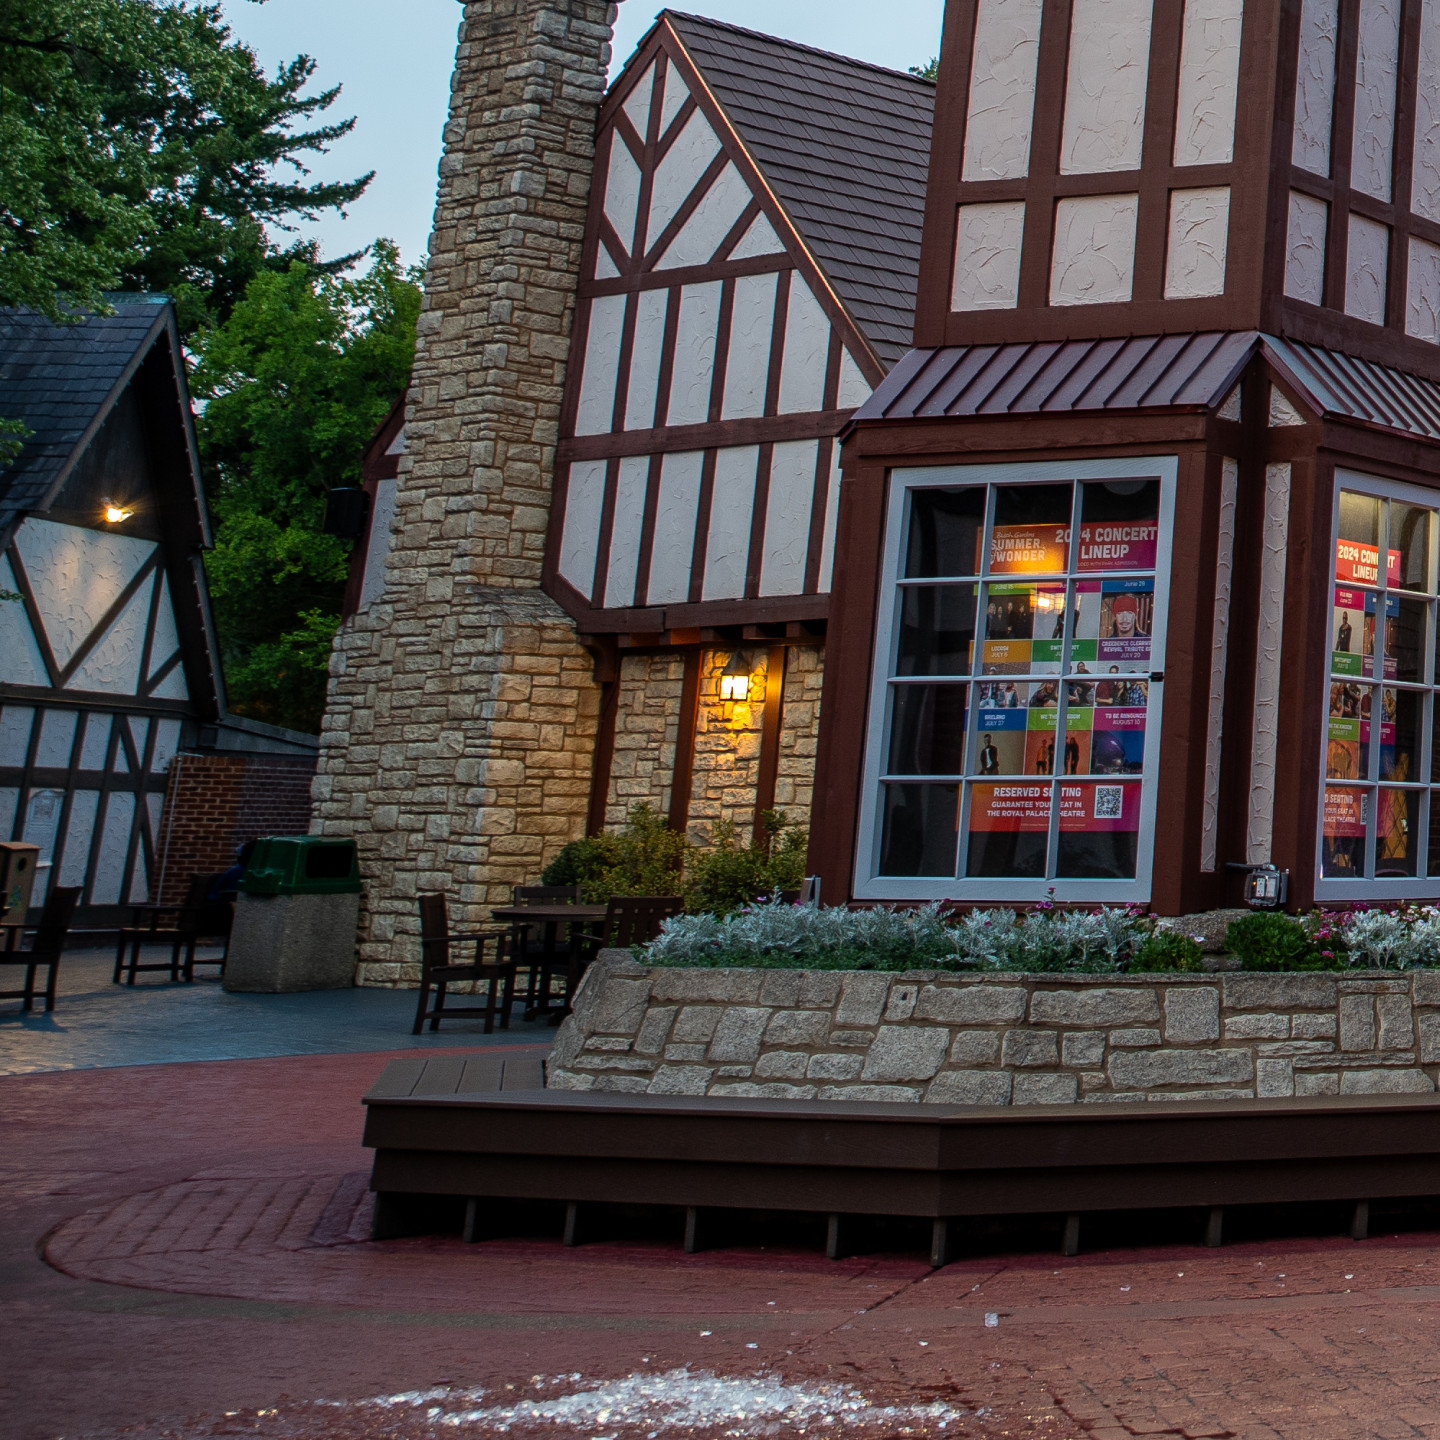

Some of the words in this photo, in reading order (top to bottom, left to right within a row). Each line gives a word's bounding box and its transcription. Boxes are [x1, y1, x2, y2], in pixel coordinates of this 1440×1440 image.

[1055, 528, 1091, 543] 204
[1095, 526, 1158, 542] CONCERT
[991, 538, 1041, 551] SUMMER
[1081, 544, 1130, 559] LINEUP
[996, 550, 1046, 563] WONDER
[1338, 544, 1360, 562] 2024
[993, 787, 1041, 797] RESERVED
[1042, 787, 1082, 797] SETING
